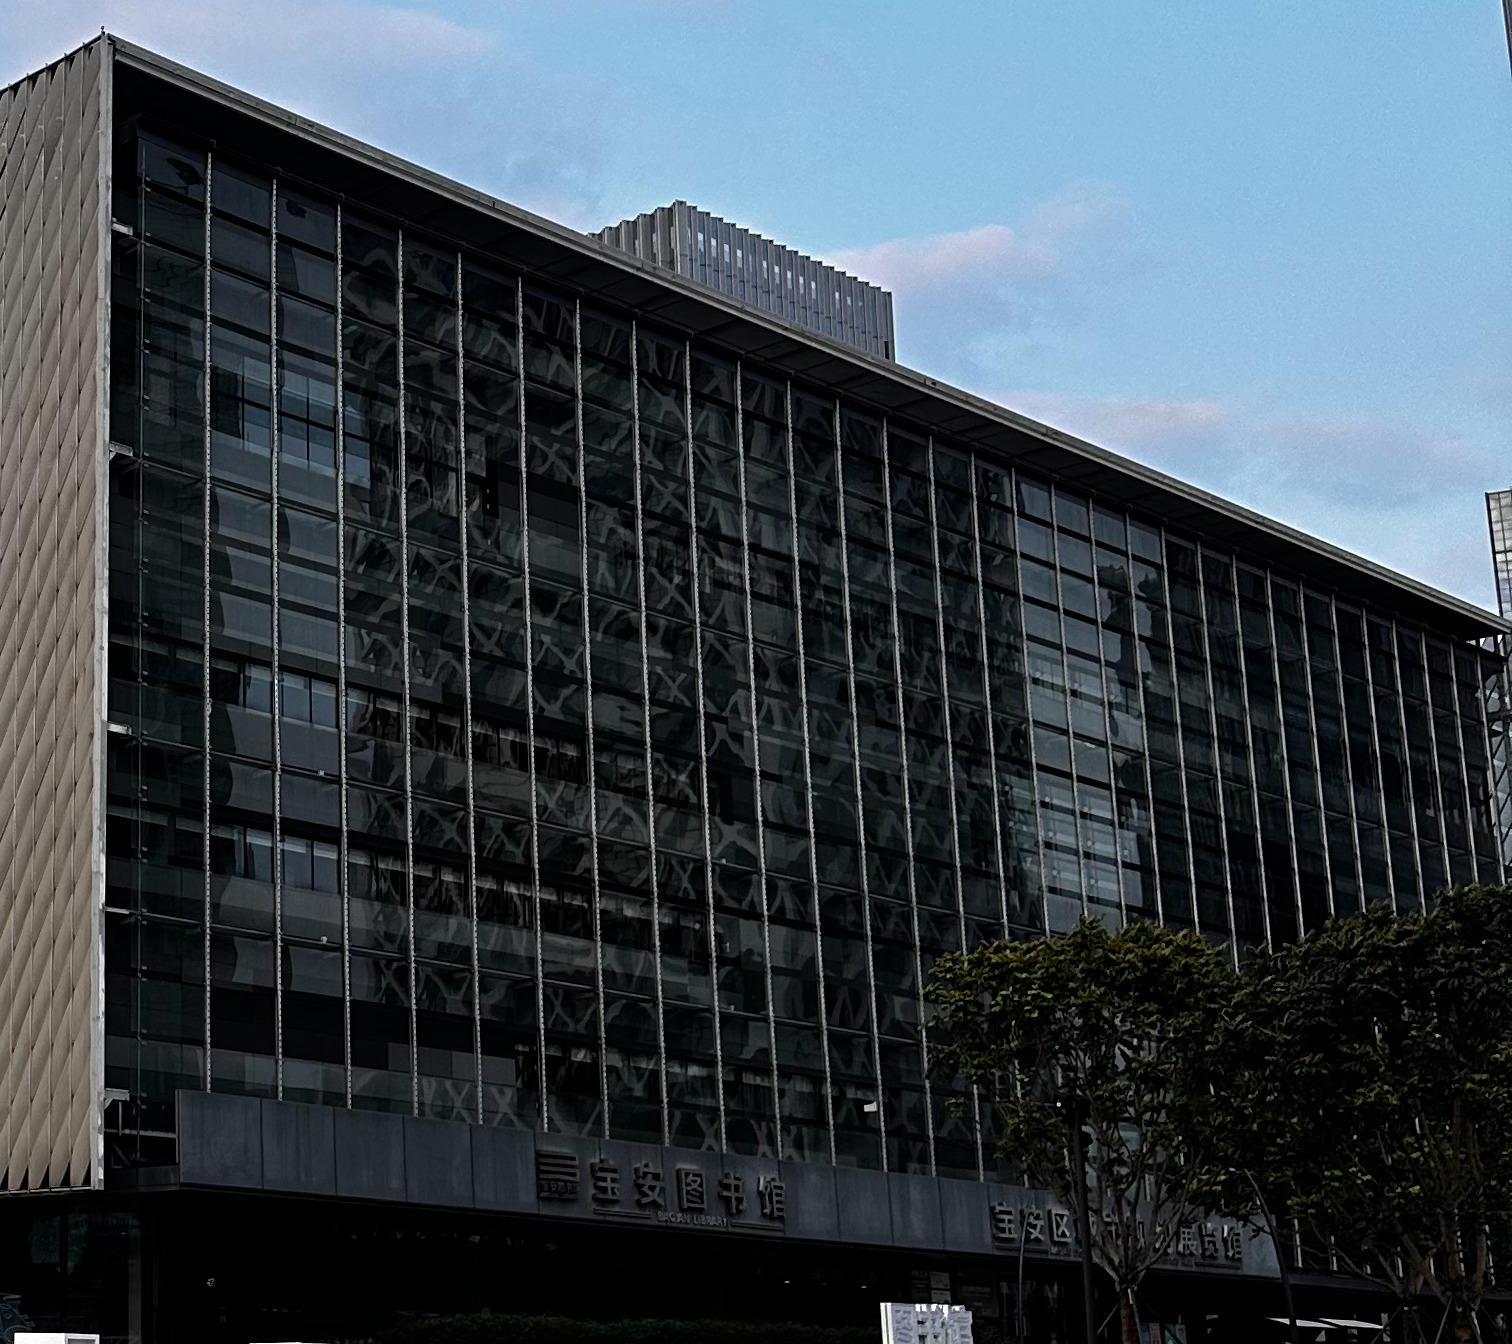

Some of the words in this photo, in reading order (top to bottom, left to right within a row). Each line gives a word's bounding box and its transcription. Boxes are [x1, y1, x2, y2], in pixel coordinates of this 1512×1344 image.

[591, 1157, 785, 1220] 宝安图书馆
